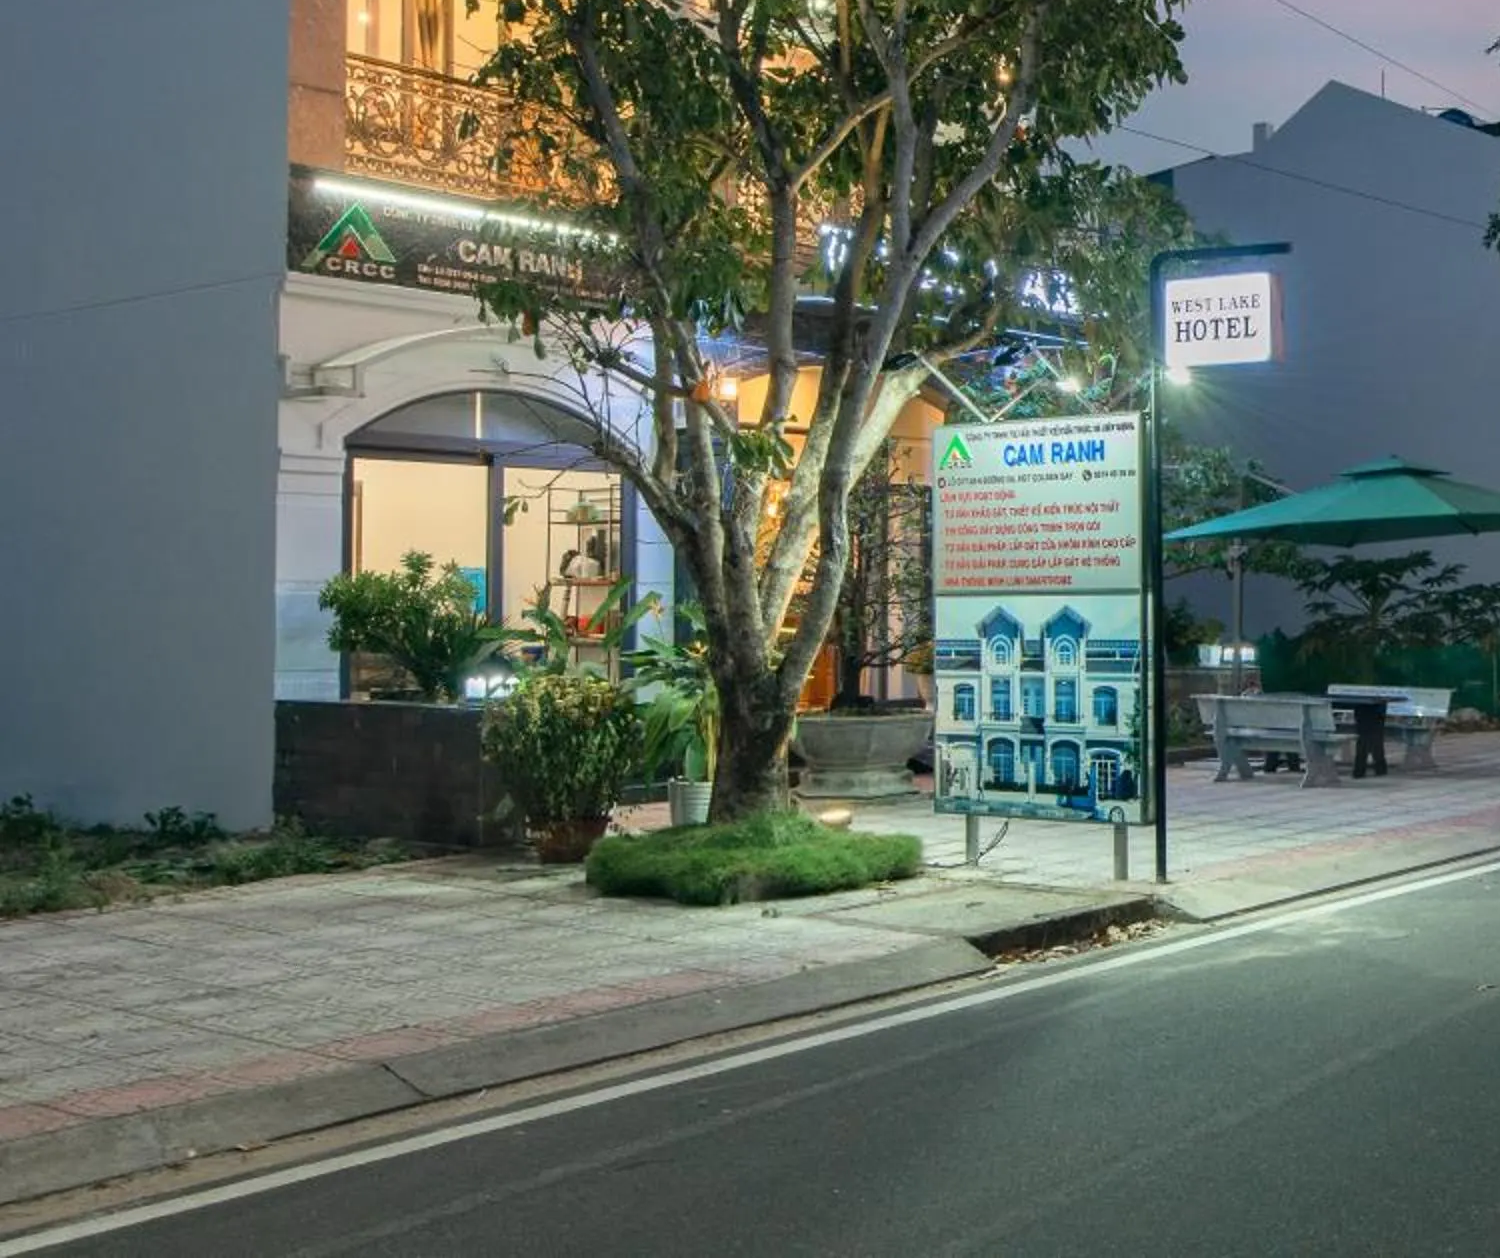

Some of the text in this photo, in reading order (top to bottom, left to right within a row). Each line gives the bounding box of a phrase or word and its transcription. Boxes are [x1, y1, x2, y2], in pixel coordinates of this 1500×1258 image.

[326, 257, 396, 279] CRCC
[458, 240, 513, 271] CAM
[1172, 294, 1261, 314] WEST LAKE
[1175, 316, 1257, 343] HOTEL
[1003, 442, 1045, 467] CAM
[1051, 439, 1105, 464] RANH
